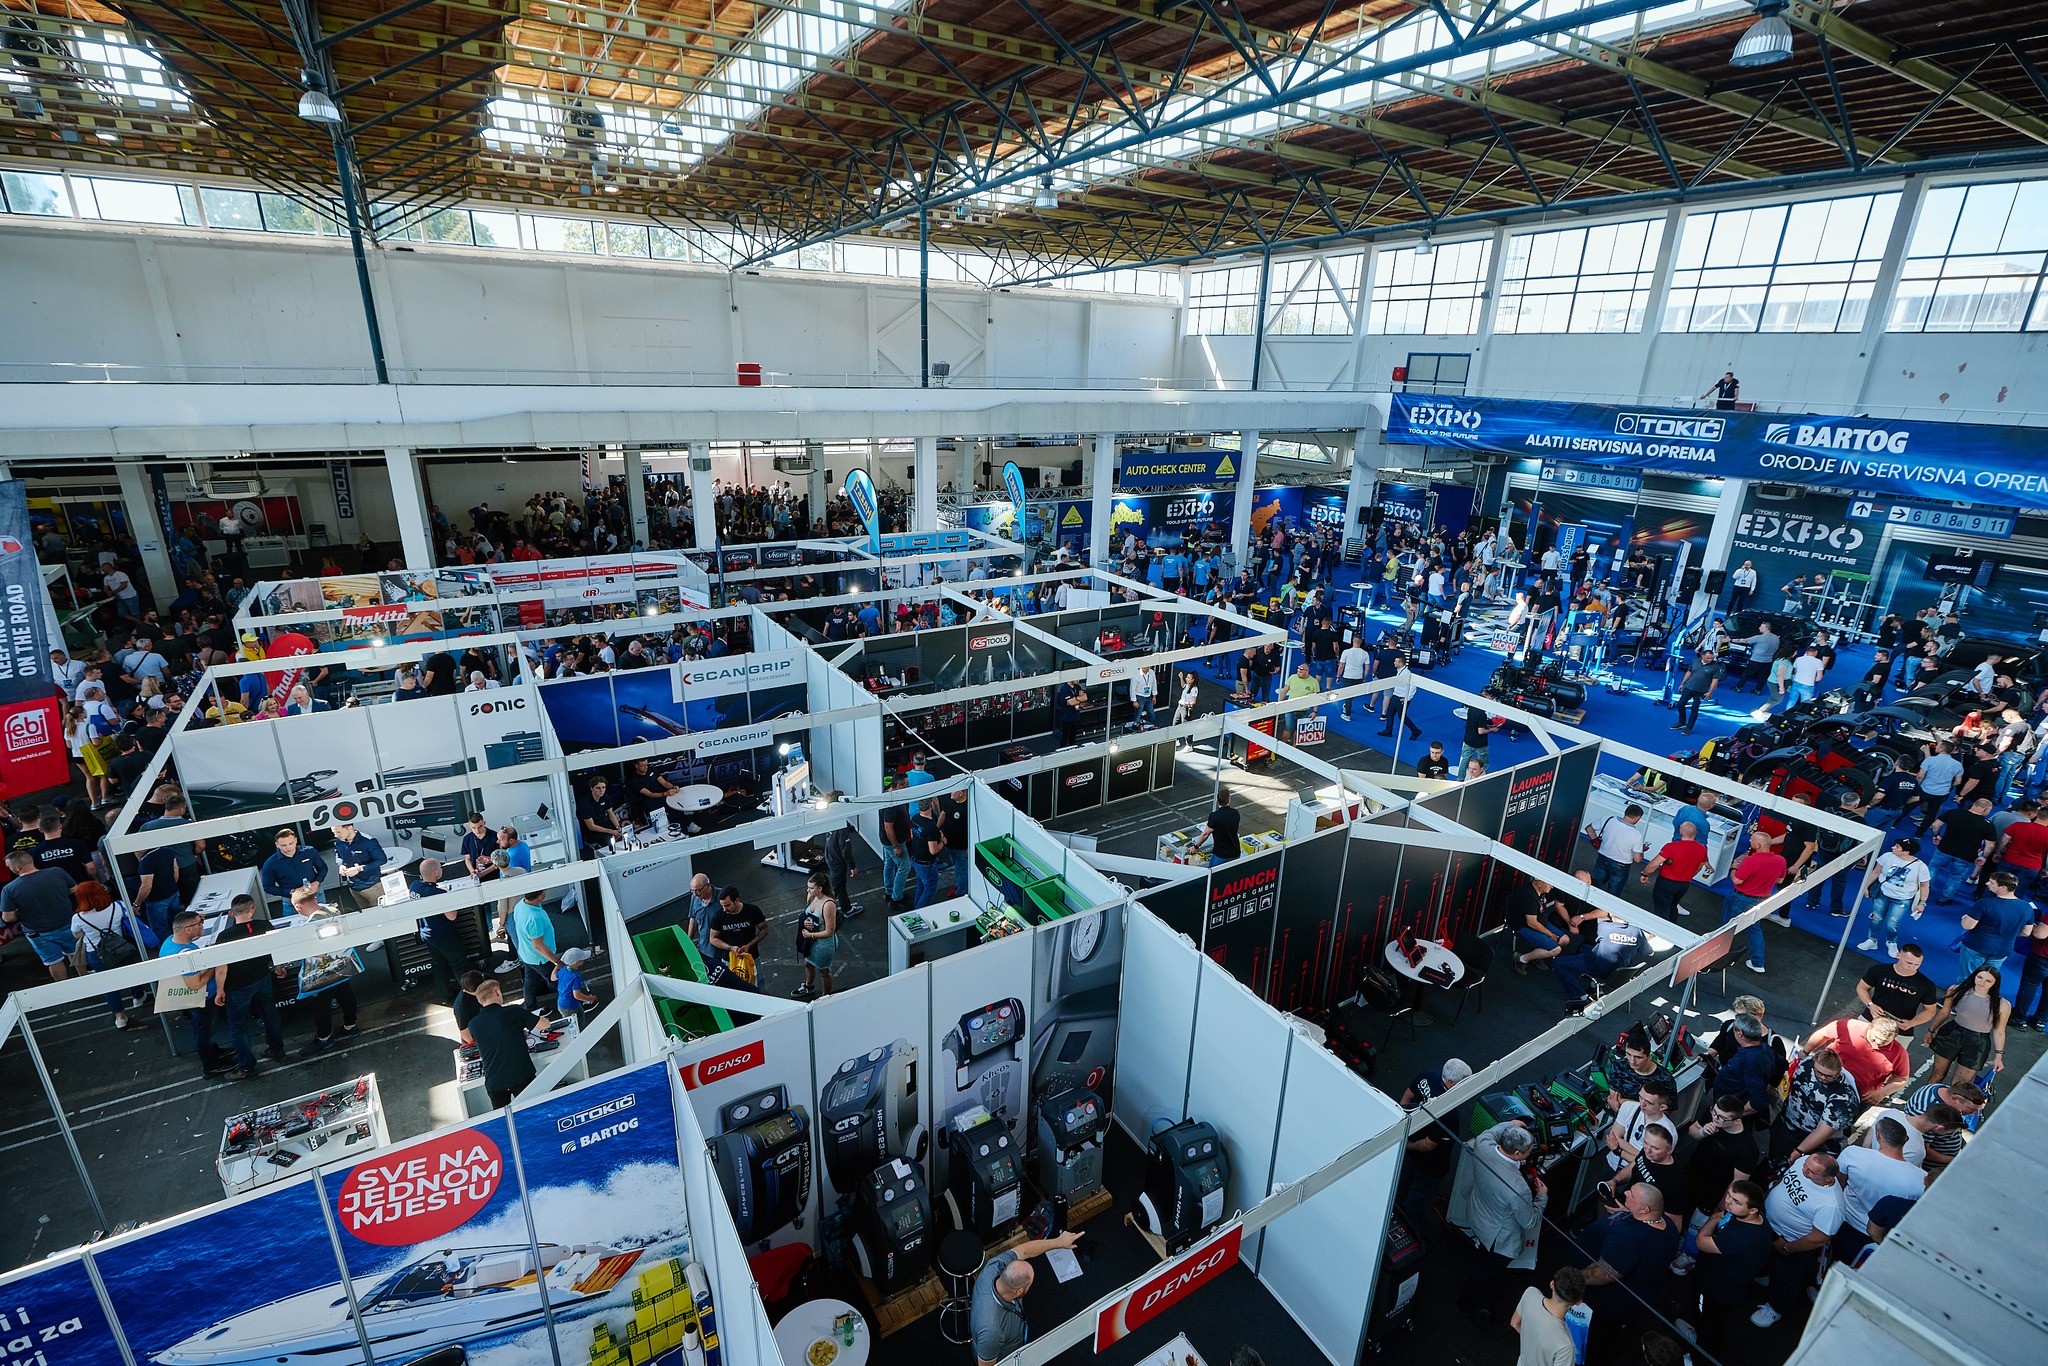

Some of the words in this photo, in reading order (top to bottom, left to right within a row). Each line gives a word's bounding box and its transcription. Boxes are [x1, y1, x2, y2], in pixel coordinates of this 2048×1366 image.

[1452, 432, 1479, 440] FUTURE
[1640, 418, 1721, 438] TOKIĆ
[1795, 424, 1910, 454] BARTOG
[1525, 433, 1564, 449] ALATI
[1572, 437, 1643, 456] SERVISNA
[1646, 443, 1716, 462] OPREMA
[1126, 465, 1149, 476] AUTO
[1150, 464, 1177, 474] CHECK
[1178, 463, 1207, 473] CENTER
[1579, 473, 1585, 481] 6
[1591, 474, 1597, 483] 8
[1614, 477, 1621, 486] 9
[1625, 478, 1634, 487] 11
[1759, 453, 1836, 474] ORODJE
[1840, 461, 1861, 475] IN
[1864, 461, 1967, 486] SERVISNA
[333, 467, 353, 518] TOKIĆ
[1913, 510, 1922, 522] 6
[1931, 512, 1941, 524] 8
[1948, 515, 1963, 527] 8a
[1971, 518, 1981, 529] 9
[1990, 520, 2005, 532] 11
[1733, 540, 1768, 552] TOOLS
[1770, 545, 1785, 553] OF
[1787, 548, 1810, 558] THE
[1811, 552, 1857, 565] FUTURE
[6, 583, 29, 624] ROAD
[12, 626, 34, 654] THE
[972, 638, 987, 648] KS
[987, 636, 1008, 645] TOOLS
[17, 655, 38, 678] ON
[693, 660, 791, 682] SCANGRIP
[1100, 670, 1111, 678] KS
[704, 731, 768, 748] SCANGRIP
[1298, 731, 1324, 743] MOLY
[1299, 721, 1324, 734] LIQUI
[12, 735, 44, 747] bilstein
[11, 750, 52, 763] www.febi.com
[1512, 770, 1553, 794] LAUNCH
[1510, 788, 1533, 801] EUROPE
[1211, 892, 1247, 910] EUROPE
[1251, 882, 1275, 895] GMBH
[1212, 867, 1277, 901] LAUNCH
[722, 921, 751, 931] BALMAIN
[706, 1052, 752, 1076] DENSO
[982, 1063, 1010, 1082] Kheos
[576, 1095, 634, 1121] TOKIĆ
[580, 1117, 639, 1148] BARTOG
[357, 1157, 428, 1189] SVE
[439, 1145, 490, 1172] NA
[342, 1159, 499, 1213] JEDNOM
[353, 1179, 491, 1230] MJESTU
[1142, 1248, 1226, 1311] DENSO
[39, 1316, 83, 1343] za
